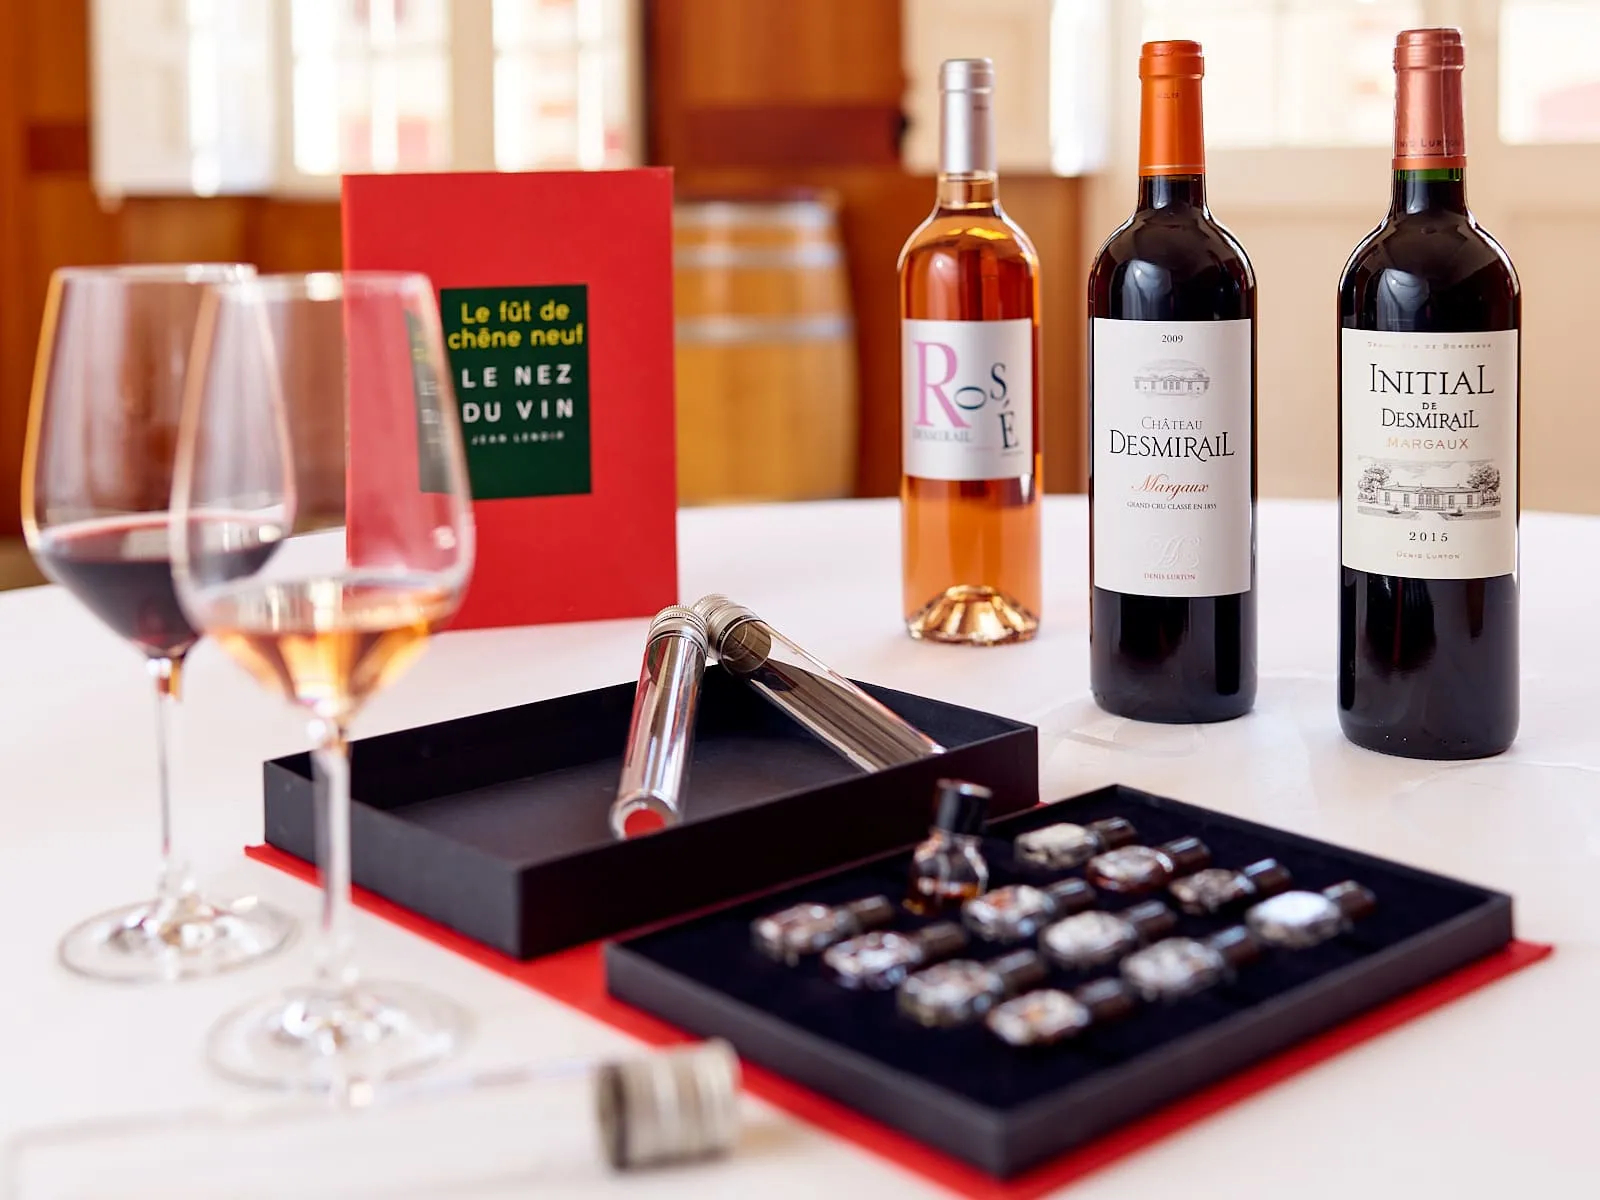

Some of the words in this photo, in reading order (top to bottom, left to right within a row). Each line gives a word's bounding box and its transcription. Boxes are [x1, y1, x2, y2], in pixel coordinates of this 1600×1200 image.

[461, 302, 490, 325] Le
[499, 299, 531, 323] fût
[540, 299, 570, 322] de
[448, 327, 522, 349] chêne
[530, 322, 584, 347] neuf
[1161, 334, 1184, 343] 2009
[461, 366, 498, 388] LE
[514, 363, 572, 386] NEZ
[1369, 363, 1495, 395] INITIAL
[462, 402, 502, 423] DU
[516, 398, 573, 420] VIN
[1422, 402, 1437, 410] DE
[1141, 415, 1203, 430] CHÂTEAU
[1381, 408, 1479, 431] DESMIRAIL
[1109, 429, 1236, 463] DESMIRAIL
[1386, 436, 1469, 450] MARGAUX
[1131, 473, 1209, 501] Margaux
[1408, 531, 1449, 542] 2015
